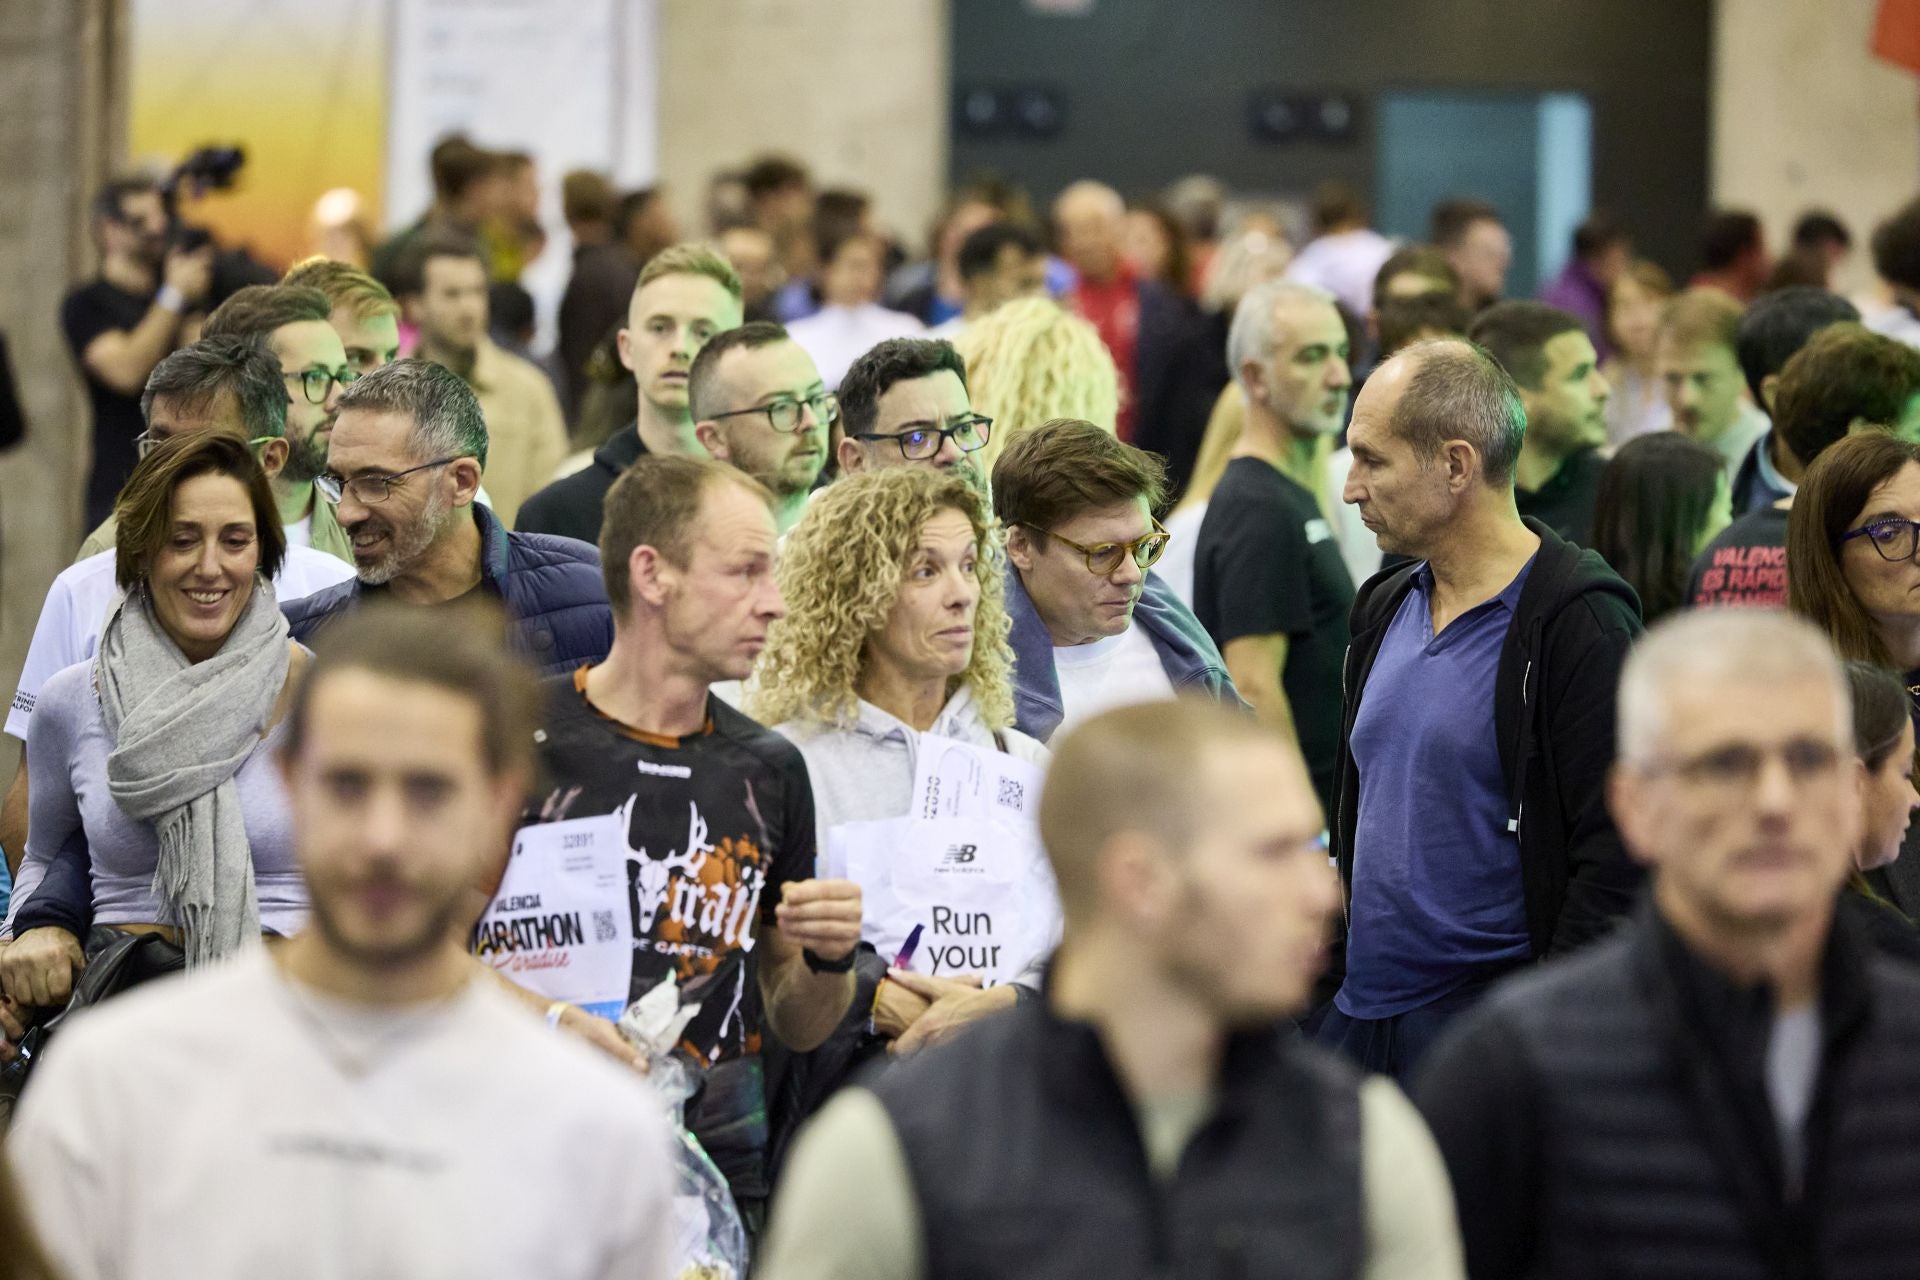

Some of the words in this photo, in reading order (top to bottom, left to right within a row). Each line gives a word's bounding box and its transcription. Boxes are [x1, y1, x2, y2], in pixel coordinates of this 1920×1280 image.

[1713, 546, 1787, 568] VALENC
[15, 695, 36, 707] RINI
[952, 866, 985, 874] balance
[932, 905, 992, 935] Run
[928, 944, 1002, 975] your
